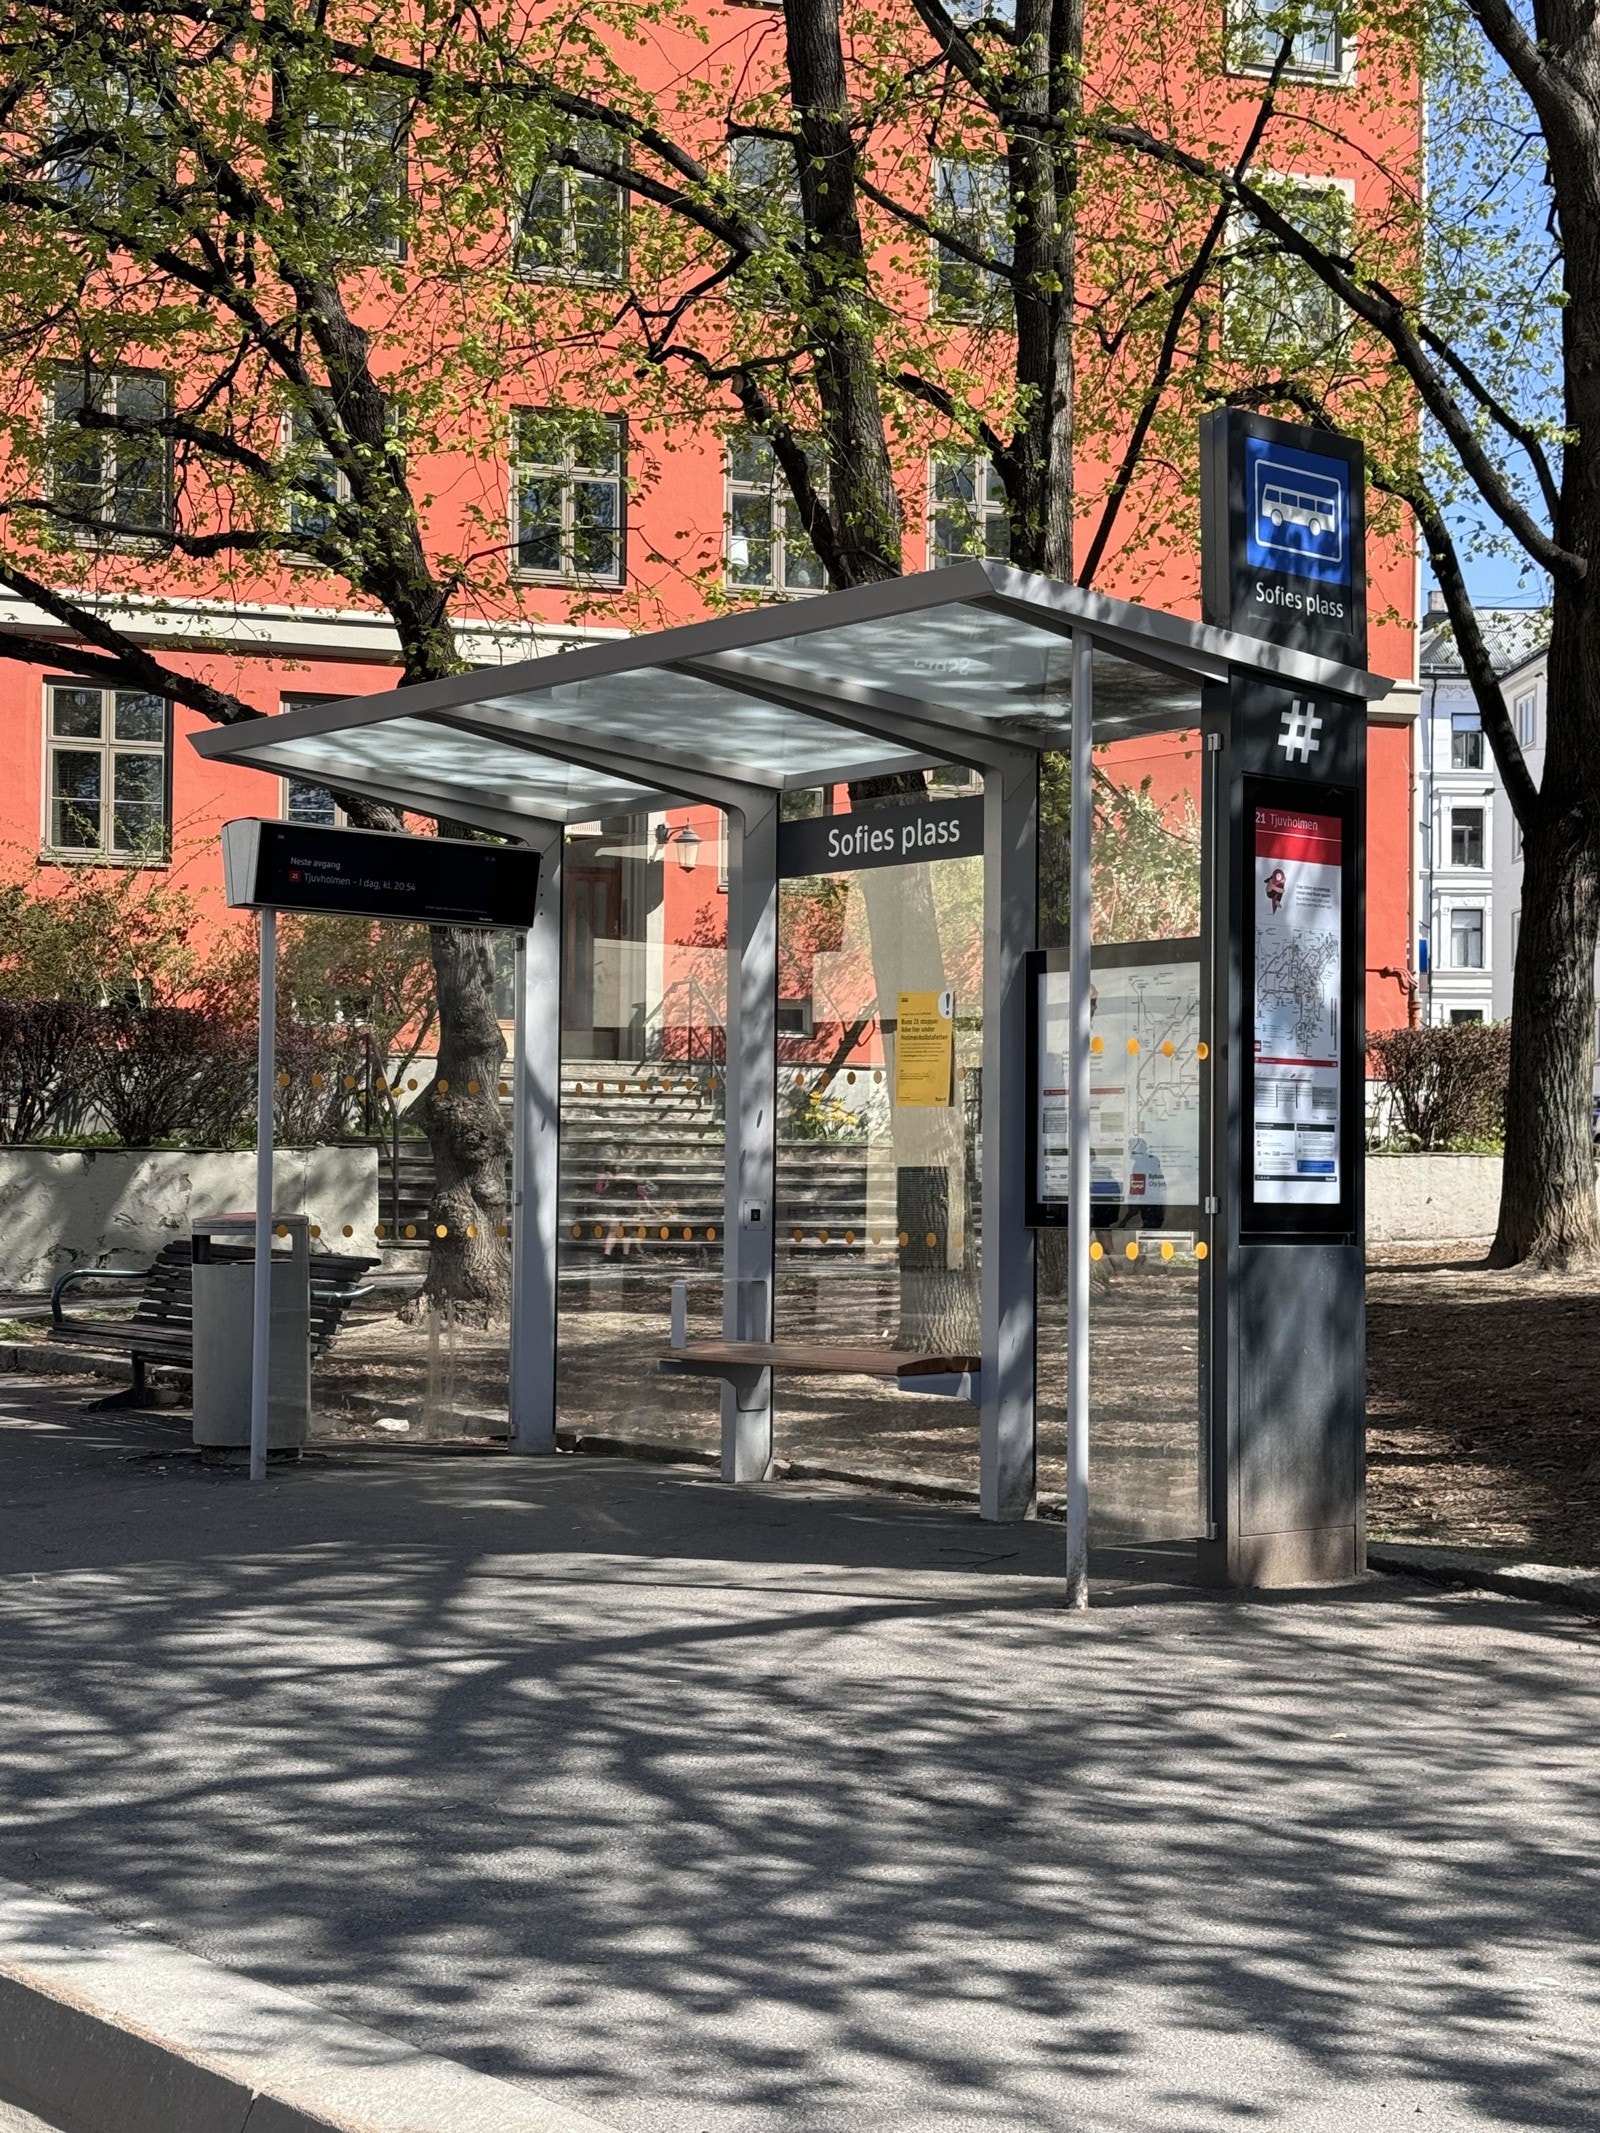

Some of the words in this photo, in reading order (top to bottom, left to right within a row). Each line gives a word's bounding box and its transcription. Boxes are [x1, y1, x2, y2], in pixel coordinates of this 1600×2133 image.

[1256, 582, 1302, 609] Sofies
[1306, 594, 1344, 618] plass
[1255, 811, 1266, 824] 21
[1269, 813, 1318, 831] Tjuvholmen
[828, 825, 894, 857] Sofies
[902, 818, 960, 855] plass
[290, 856, 312, 867] Neste
[312, 859, 341, 871] avgang
[304, 872, 350, 886] Tjuvholmen
[363, 879, 380, 891] dag,
[393, 881, 416, 891] 20:54
